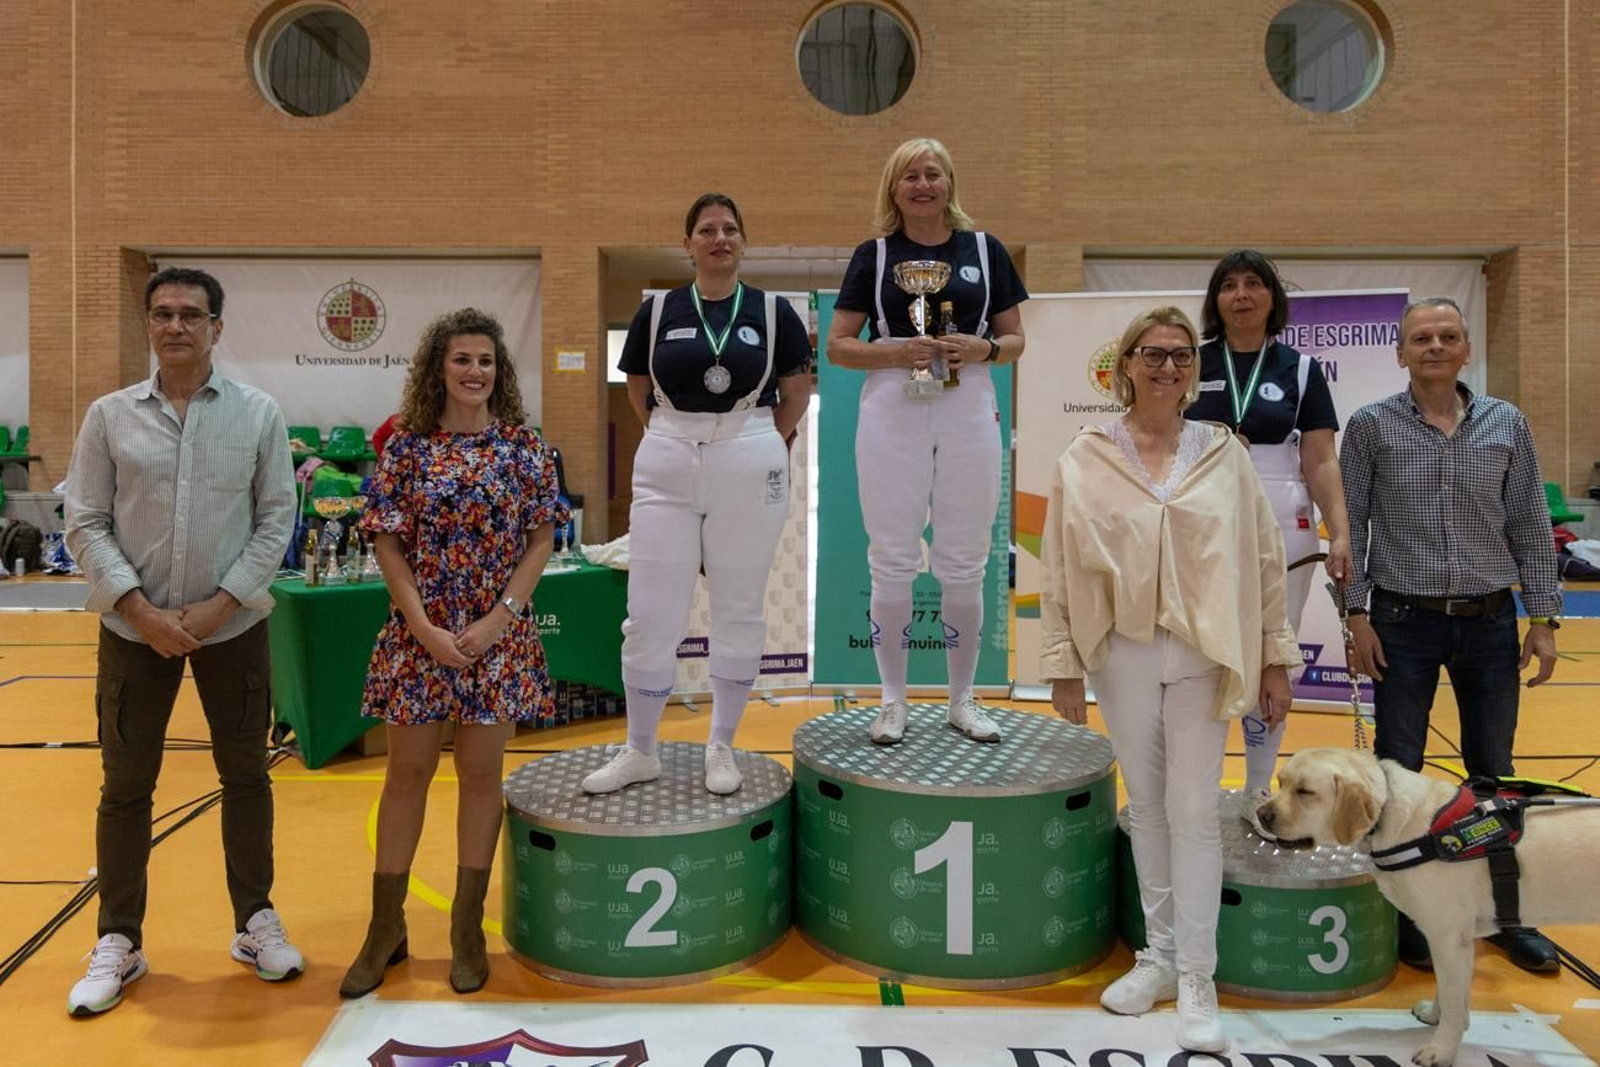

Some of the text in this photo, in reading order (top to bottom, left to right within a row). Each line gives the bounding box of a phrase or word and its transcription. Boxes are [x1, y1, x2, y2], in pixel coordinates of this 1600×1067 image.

[1284, 323, 1399, 348] DE ESGRIMA
[624, 867, 677, 947] 2
[914, 821, 973, 955] 1
[1308, 905, 1349, 974] 3
